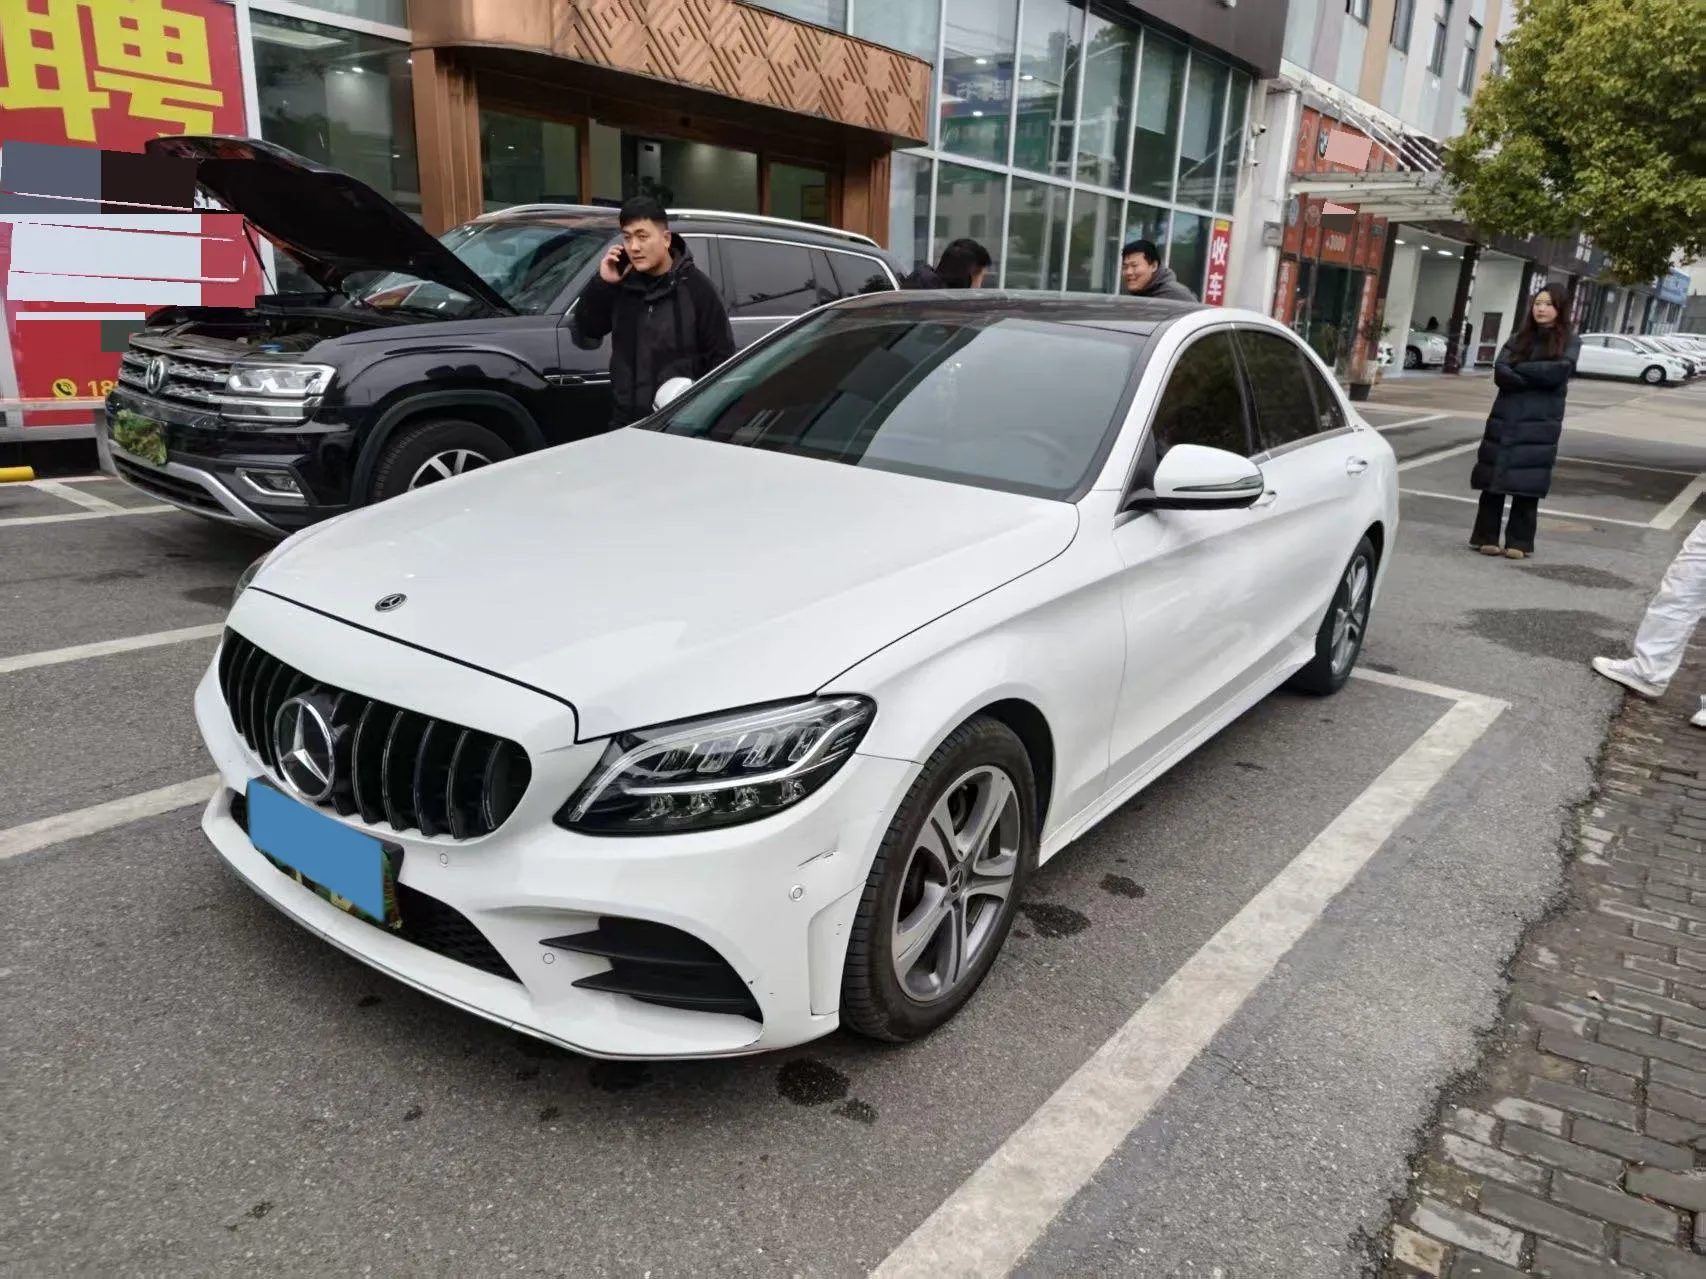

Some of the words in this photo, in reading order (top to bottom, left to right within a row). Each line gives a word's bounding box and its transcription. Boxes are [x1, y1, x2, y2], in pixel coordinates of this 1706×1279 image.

[0, 0, 224, 144] 聘
[1207, 235, 1229, 302] 收车
[87, 380, 119, 397] 18
